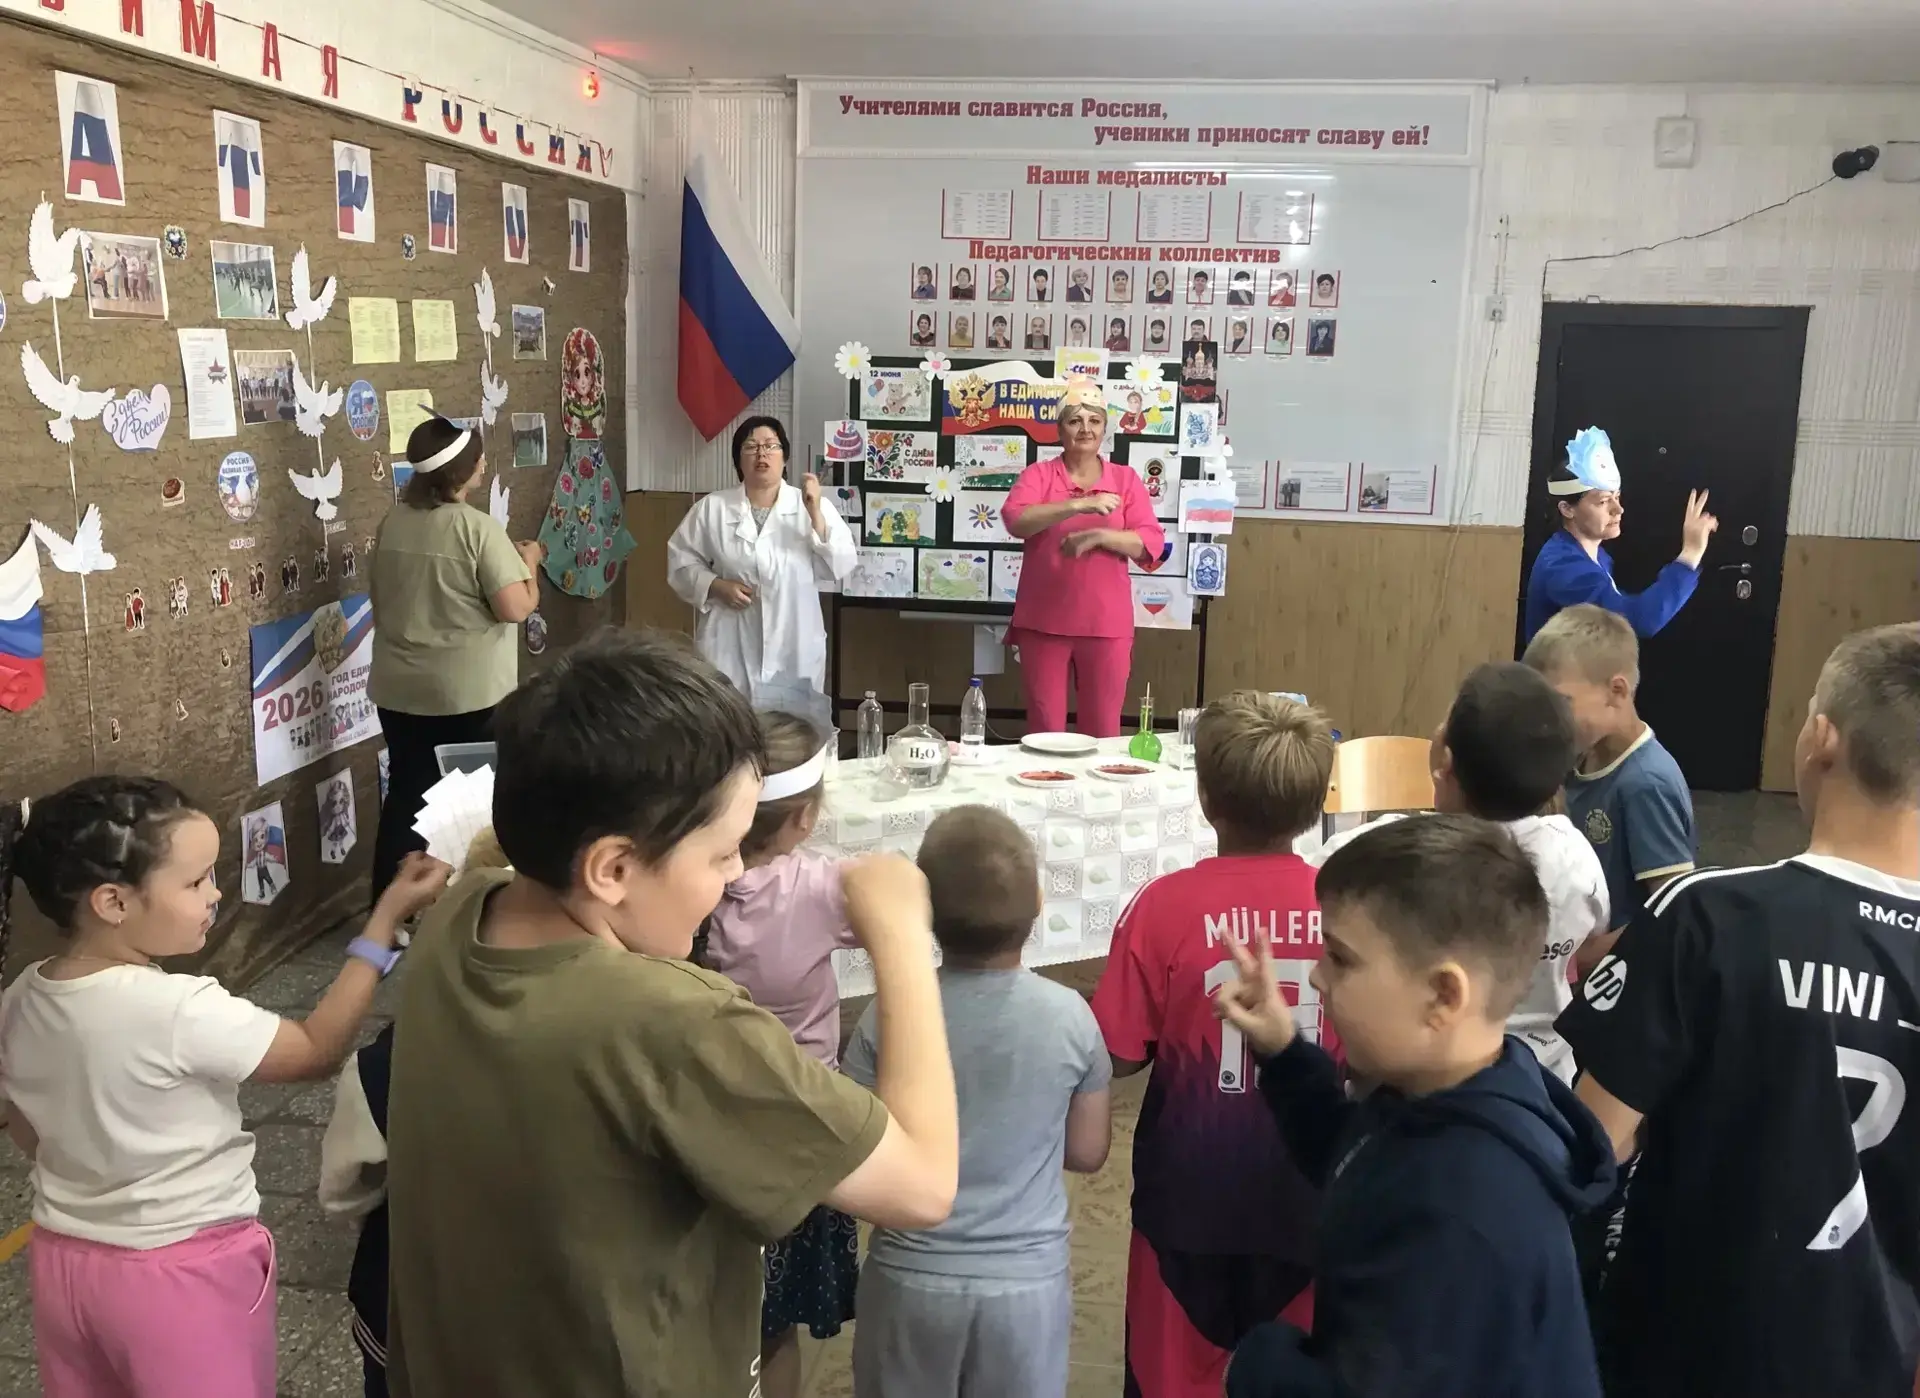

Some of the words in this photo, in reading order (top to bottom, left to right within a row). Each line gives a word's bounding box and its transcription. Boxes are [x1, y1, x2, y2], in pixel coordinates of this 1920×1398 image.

[838, 95, 961, 117] Учителями
[967, 99, 1074, 118] славится
[1080, 97, 1169, 121] Россия,
[1094, 125, 1190, 146] ученики
[1197, 126, 1311, 148] приносят
[1316, 128, 1385, 150] славу
[1391, 125, 1430, 147] ей!
[1026, 165, 1090, 186] Наши
[1096, 169, 1228, 189] медалисты
[1158, 246, 1281, 264] коллектив
[869, 369, 879, 378] 12
[999, 383, 1008, 399] В
[999, 403, 1035, 420] НАША
[1039, 404, 1058, 421] СИ
[904, 449, 911, 457] С
[911, 448, 935, 458] ДНЁМ
[903, 458, 935, 467] РОССИИ
[331, 673, 350, 686] ГОД
[262, 680, 324, 732] 2026
[909, 747, 936, 760] H2O
[1777, 958, 1886, 1022] VINI
